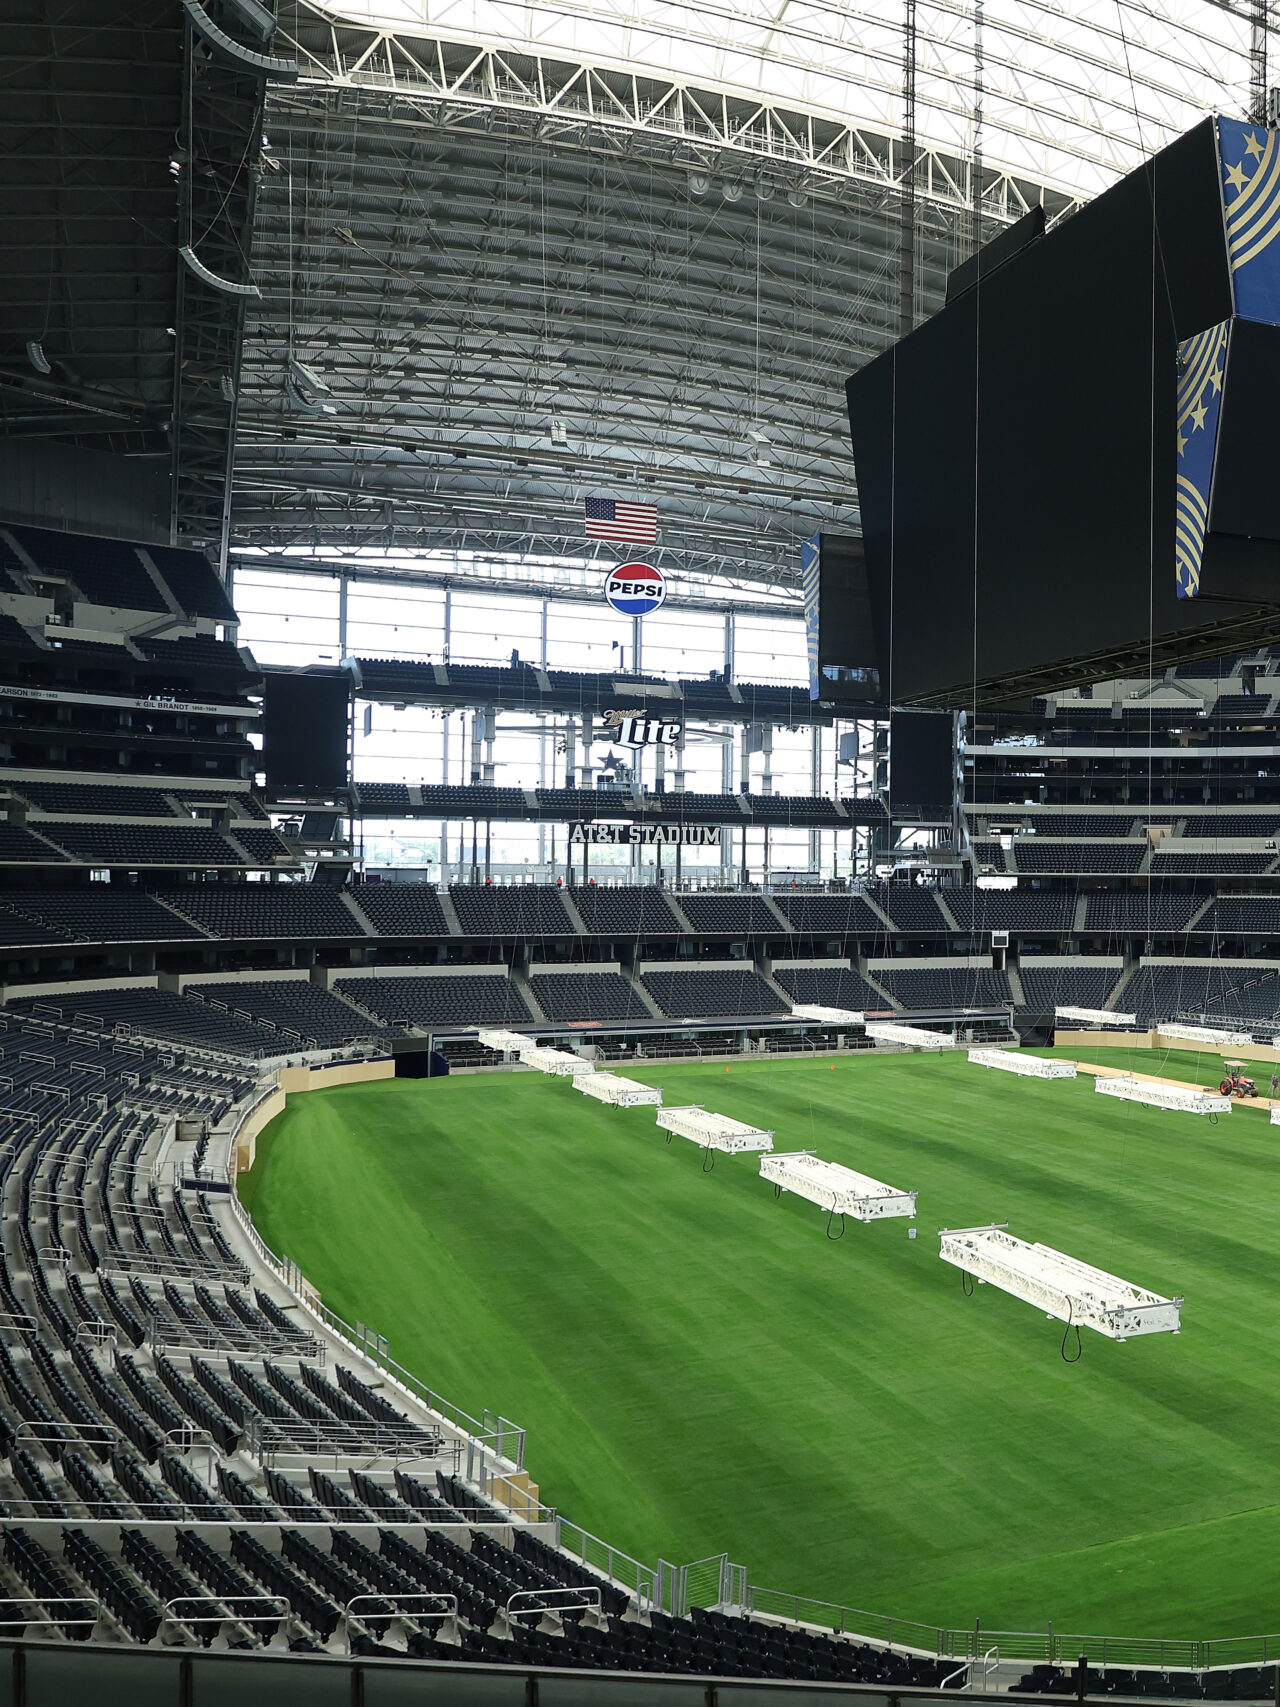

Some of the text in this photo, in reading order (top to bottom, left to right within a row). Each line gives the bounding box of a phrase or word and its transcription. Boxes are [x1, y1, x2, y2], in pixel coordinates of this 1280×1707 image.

[609, 582, 663, 597] PEPSI
[158, 702, 189, 710] BRANDT
[615, 717, 681, 750] Lite
[570, 824, 721, 845] AT&T STADIUM
